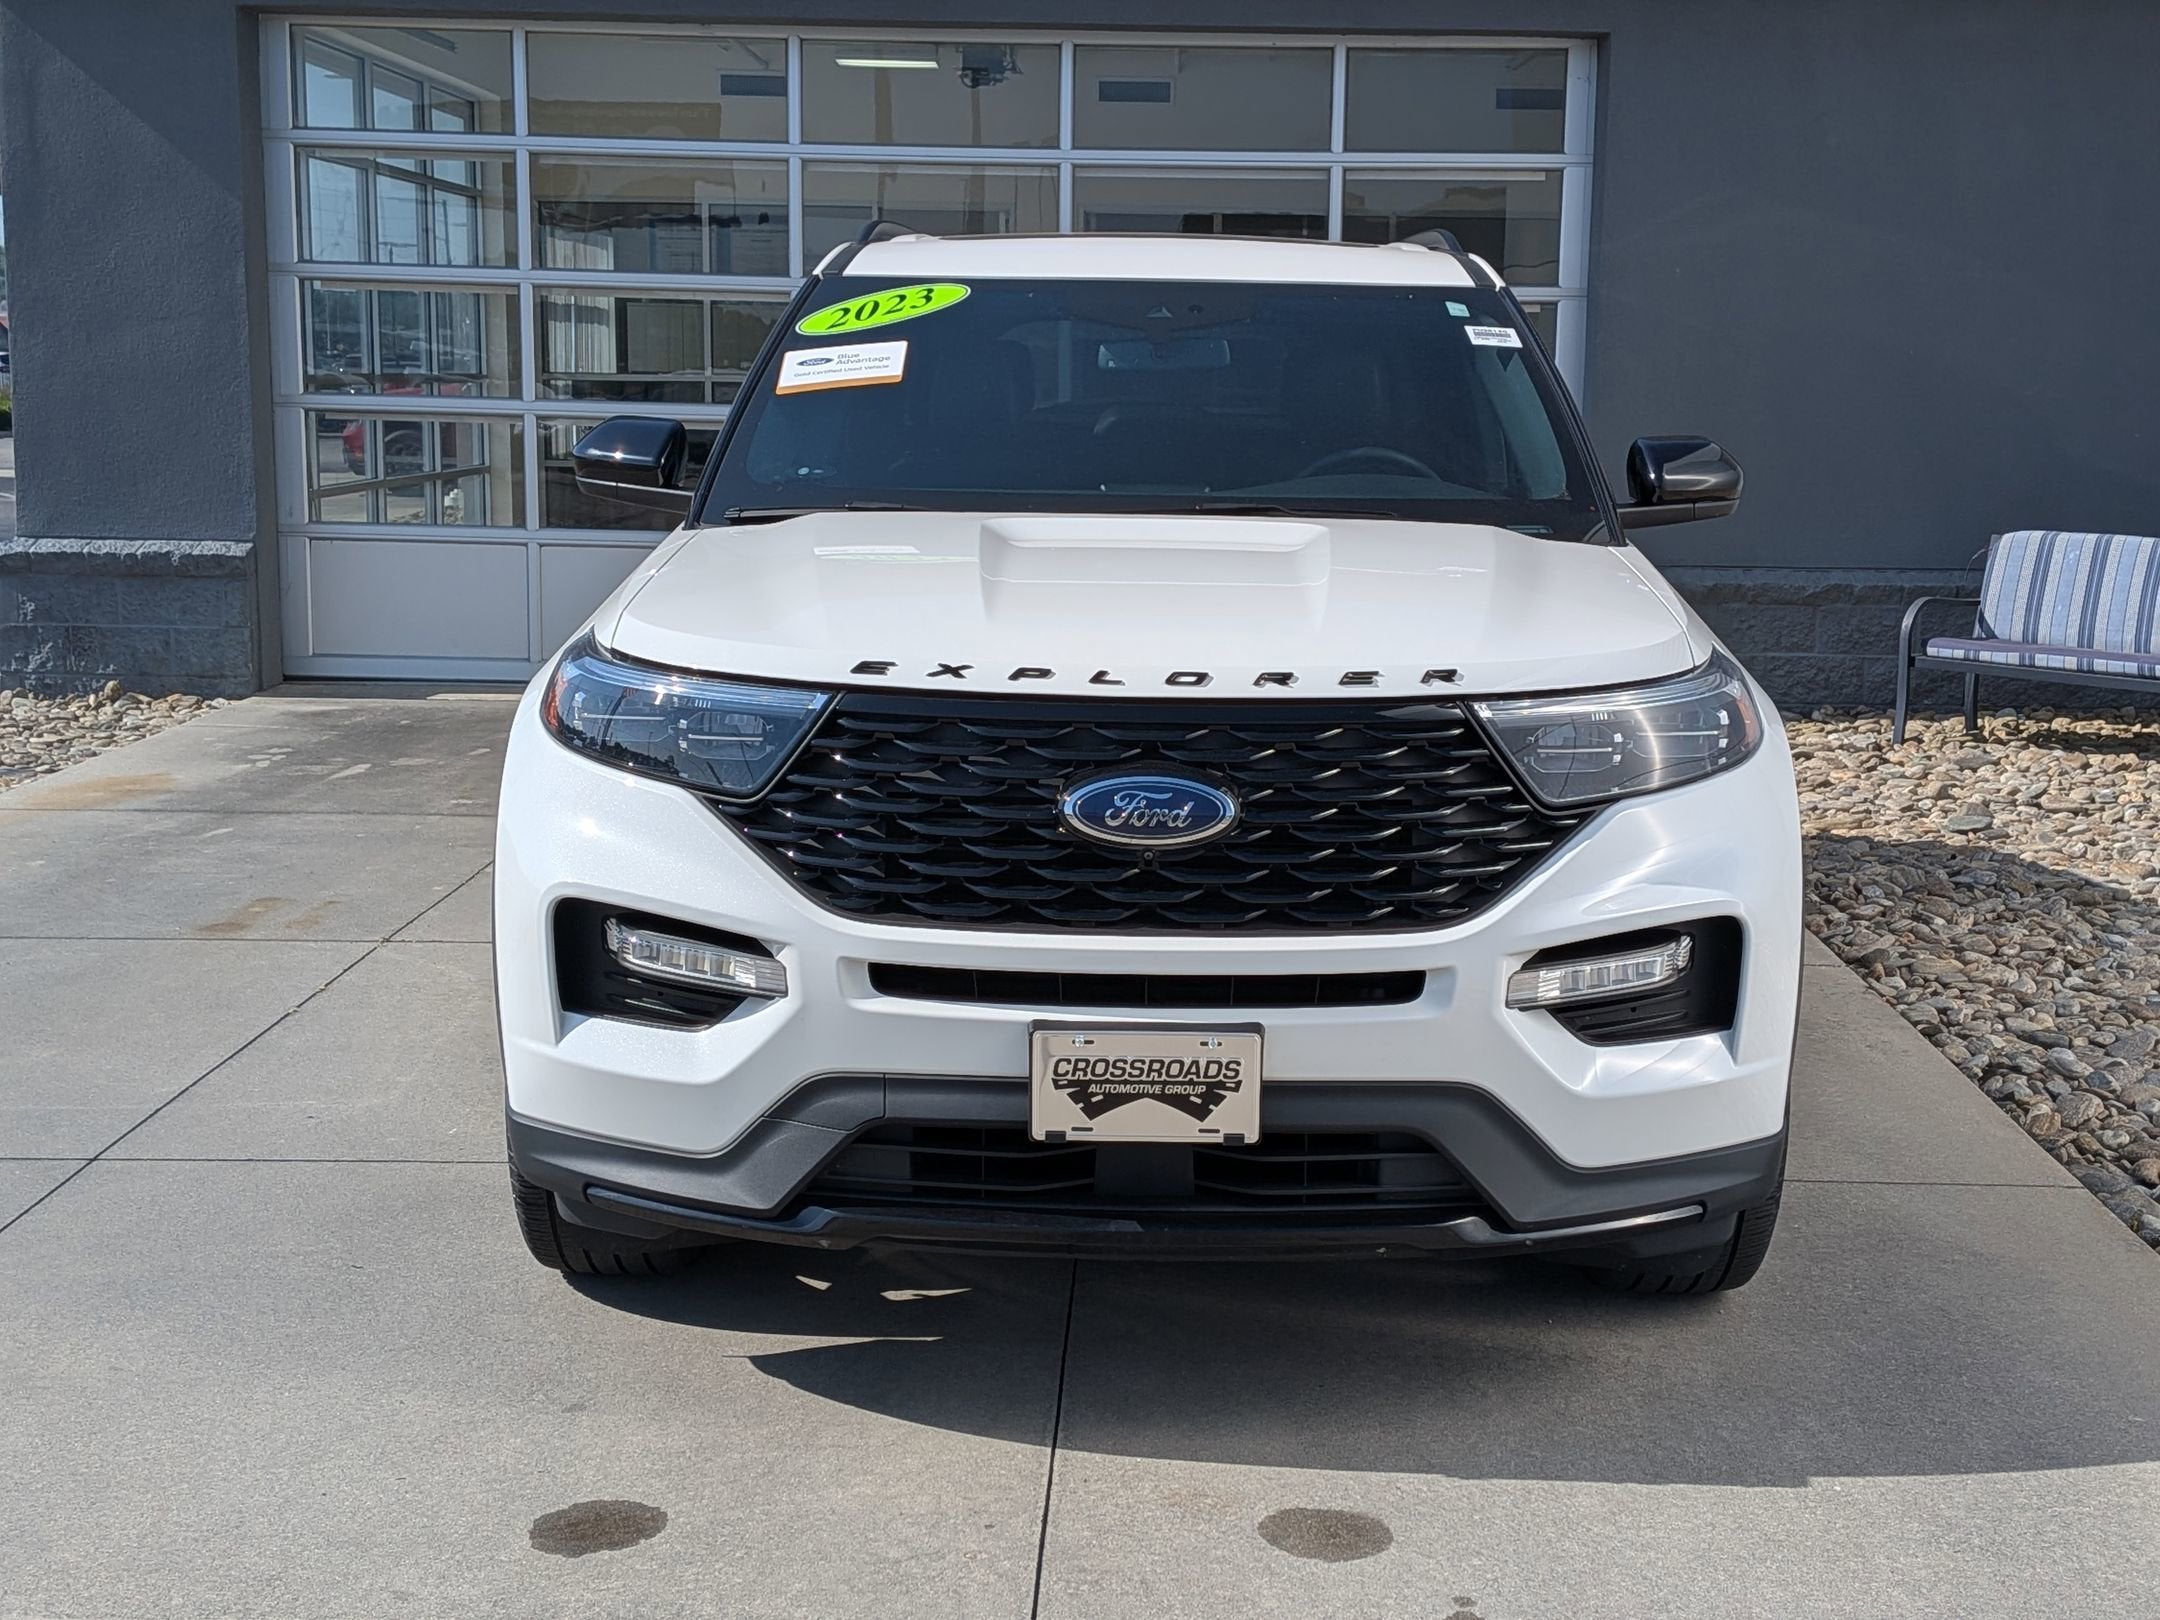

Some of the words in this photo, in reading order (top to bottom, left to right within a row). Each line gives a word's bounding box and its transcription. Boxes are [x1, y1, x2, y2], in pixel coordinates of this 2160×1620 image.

[825, 287, 935, 330] 2023
[835, 355, 891, 366] Advantage
[837, 352, 860, 360] Blue
[812, 368, 843, 376] Certified
[864, 363, 890, 371] Vehicle
[849, 660, 1466, 688] EXPLORER
[1104, 790, 1195, 828] Ford
[1052, 1057, 1242, 1081] CROSSROADS
[1087, 1083, 1162, 1095] AUTOMOTIVE
[1164, 1084, 1207, 1095] GROUP
